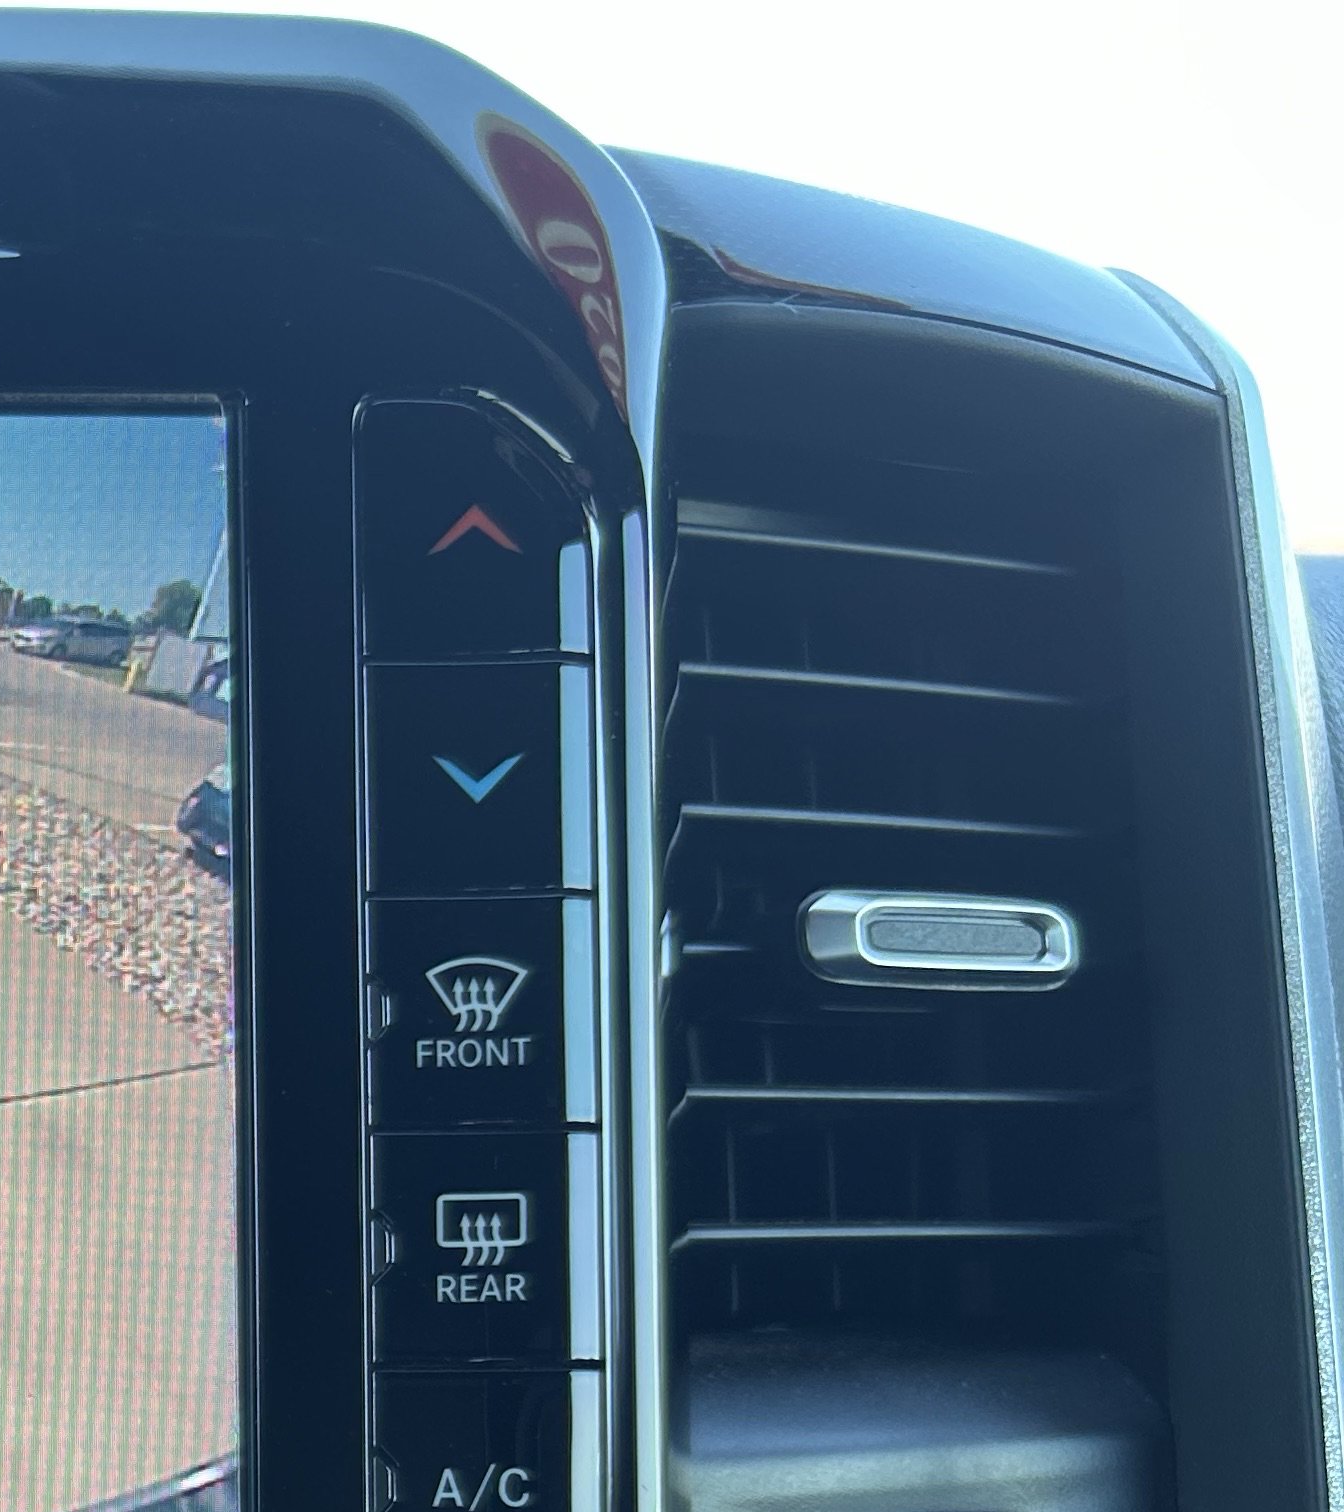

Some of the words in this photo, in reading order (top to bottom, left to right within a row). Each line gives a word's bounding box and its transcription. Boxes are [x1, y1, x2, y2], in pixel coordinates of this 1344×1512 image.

[416, 1038, 532, 1069] FRONT
[435, 1273, 526, 1303] REAR
[432, 1464, 531, 1511] A/C
